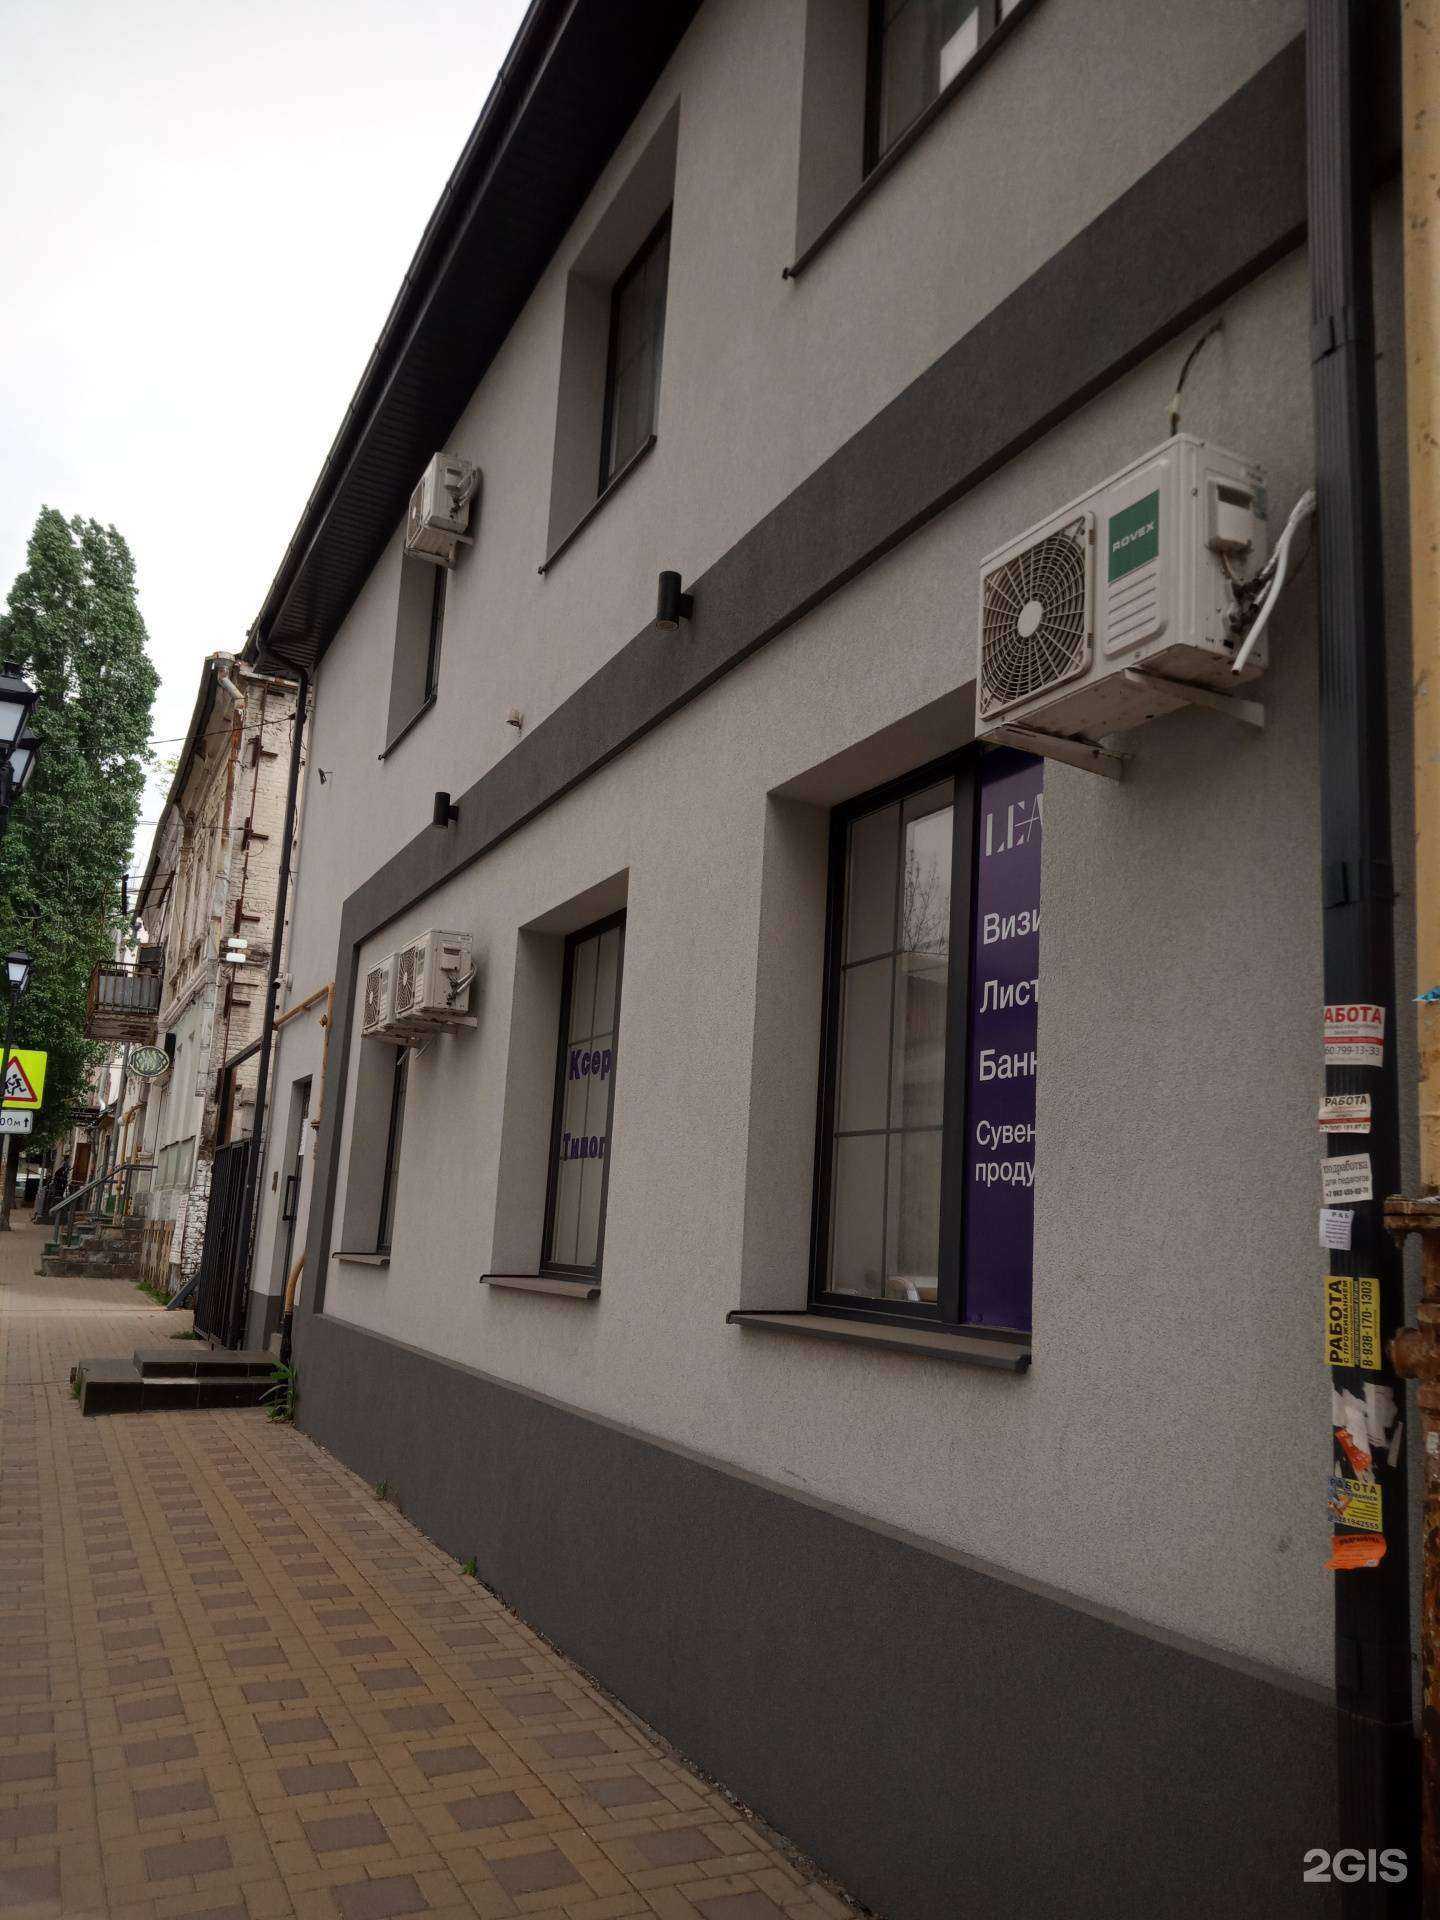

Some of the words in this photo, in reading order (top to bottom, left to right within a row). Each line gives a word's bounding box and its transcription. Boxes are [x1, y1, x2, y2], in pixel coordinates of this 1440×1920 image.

[1112, 521, 1155, 553] ROVEX
[1324, 1094, 1367, 1107] РАБОТА
[1328, 1279, 1343, 1364] РАБОТА
